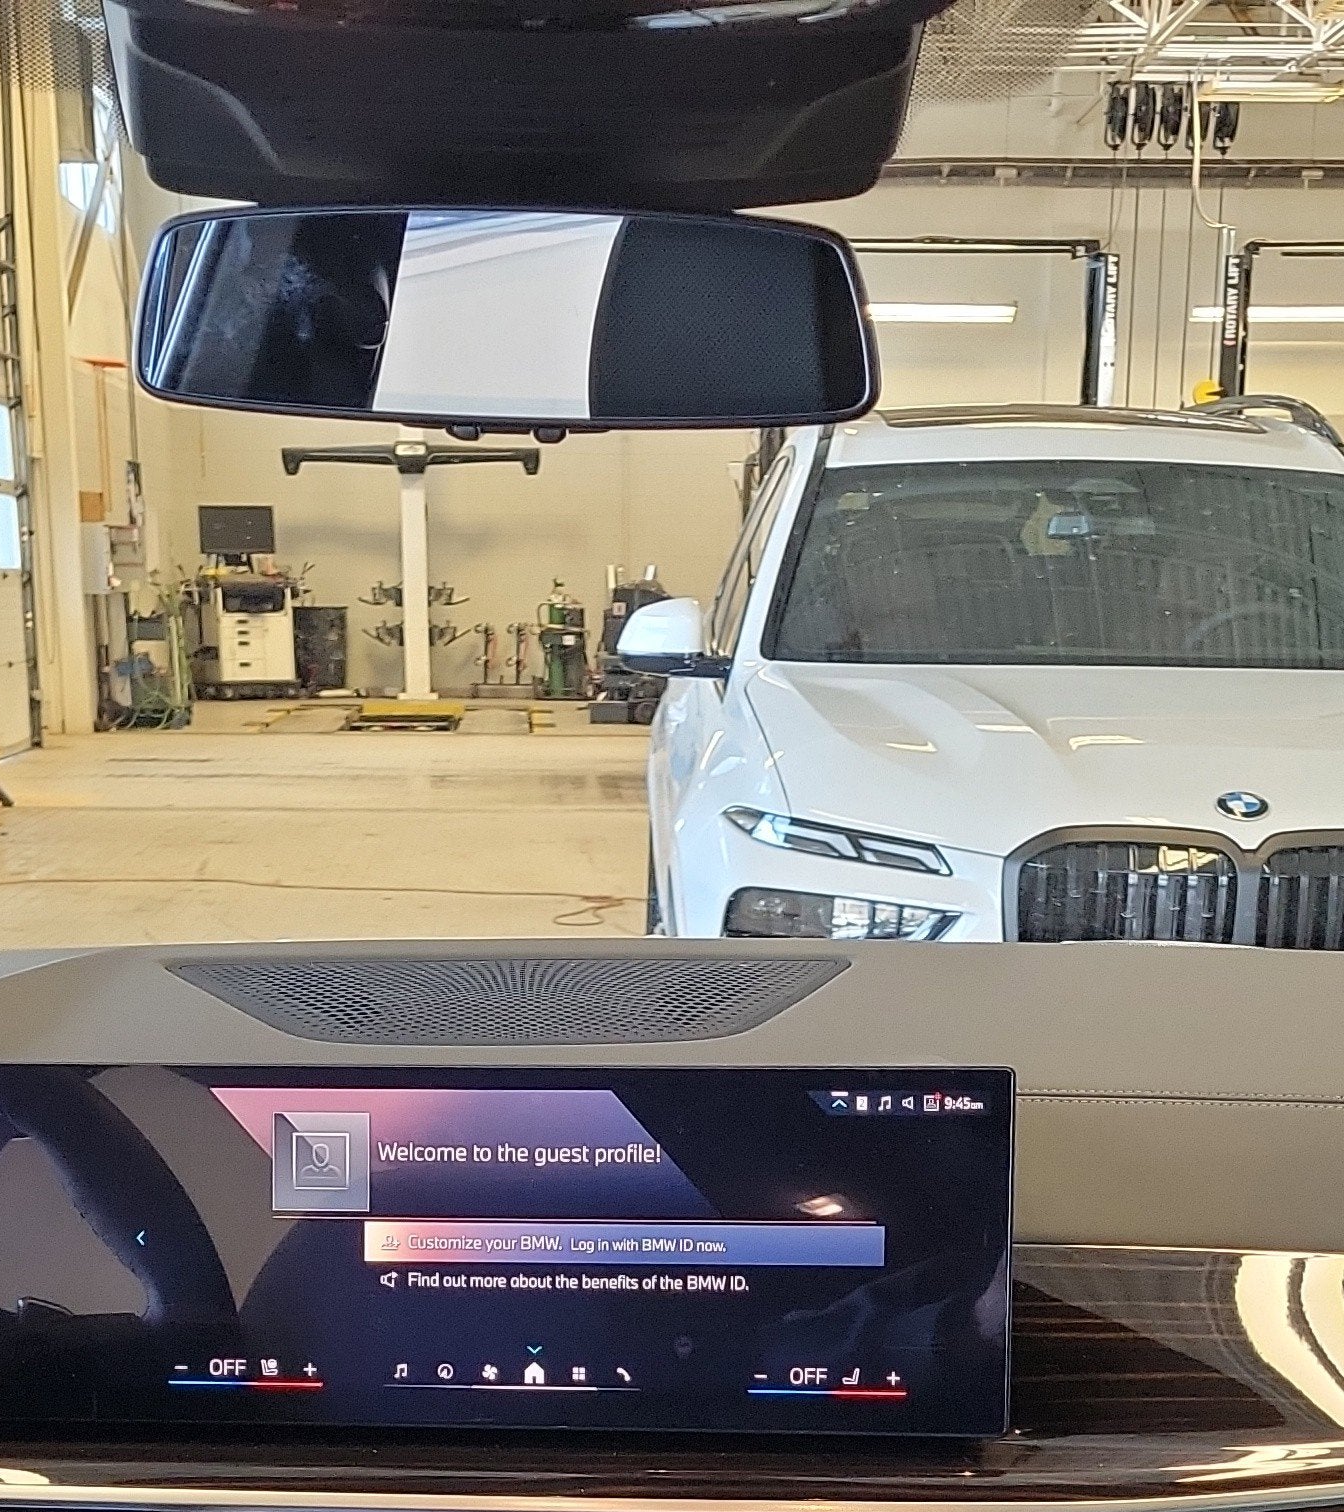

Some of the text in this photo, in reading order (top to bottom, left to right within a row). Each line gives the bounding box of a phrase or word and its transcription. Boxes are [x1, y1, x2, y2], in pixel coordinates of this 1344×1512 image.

[1227, 257, 1240, 285] LIFT
[944, 1097, 984, 1110] 9:45am
[377, 1141, 662, 1167] Welcome to the guest profile!
[408, 1235, 727, 1253] Customize your BMW. Log in with BMW ID now.
[407, 1272, 749, 1291] Find out more about the benefits of the BMW ID.
[209, 1358, 247, 1376] OFF
[789, 1367, 828, 1385] OFF
